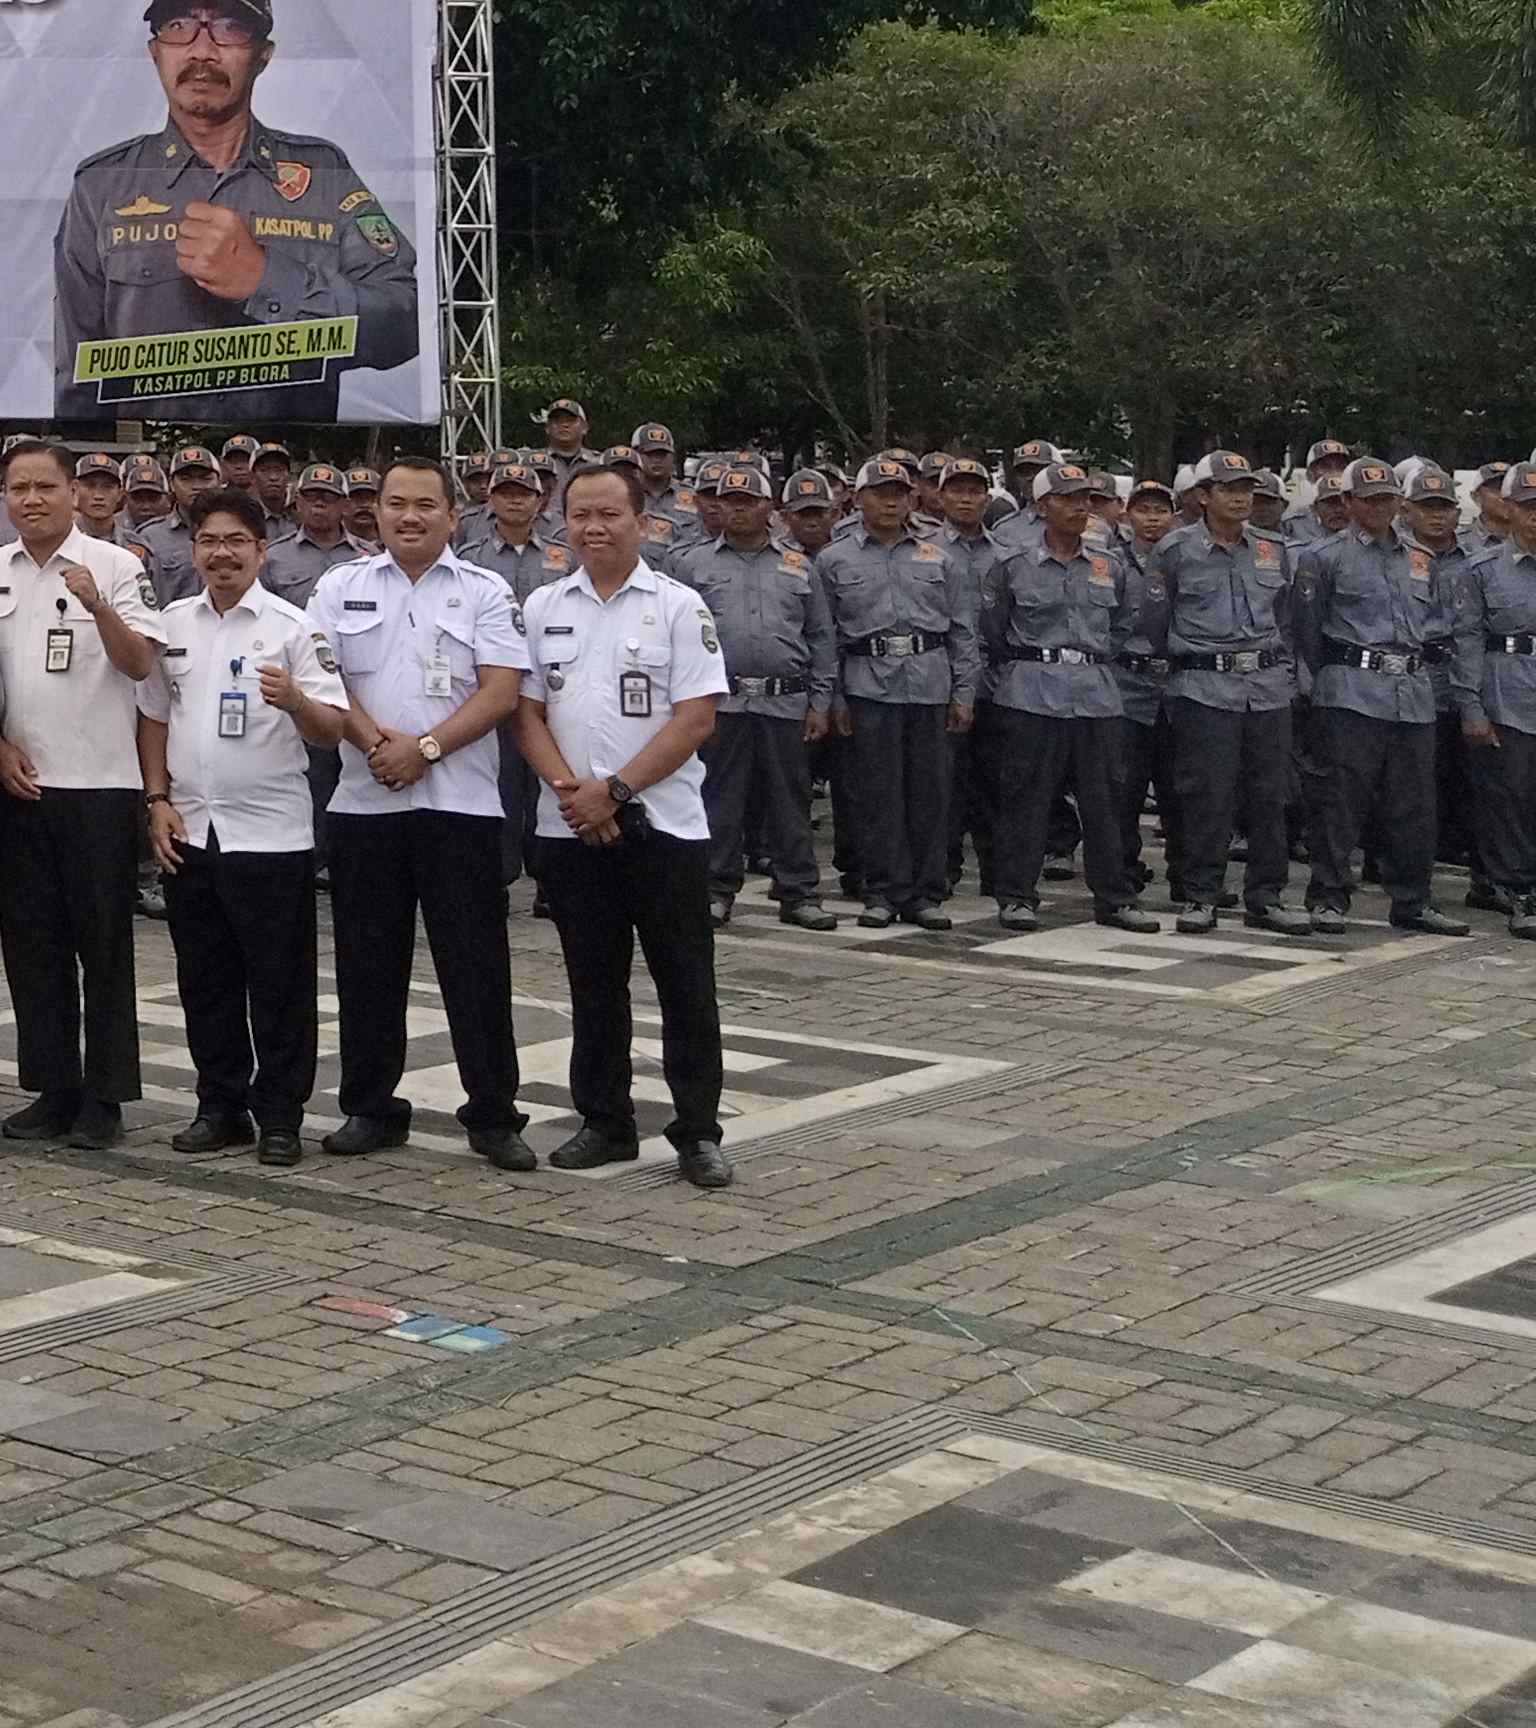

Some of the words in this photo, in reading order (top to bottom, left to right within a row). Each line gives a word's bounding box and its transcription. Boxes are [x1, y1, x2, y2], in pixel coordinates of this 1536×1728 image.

[112, 223, 177, 245] PUJO
[255, 216, 316, 239] KASATPOL
[317, 223, 333, 241] PP
[89, 345, 130, 374] PUJO
[134, 340, 189, 369] CATUR
[192, 332, 272, 363] SUSANTO
[275, 329, 301, 357] SE,
[305, 325, 348, 353] M.M.
[133, 373, 211, 396] KASATPOL
[216, 371, 235, 387] PP
[239, 364, 290, 385] BLORA
